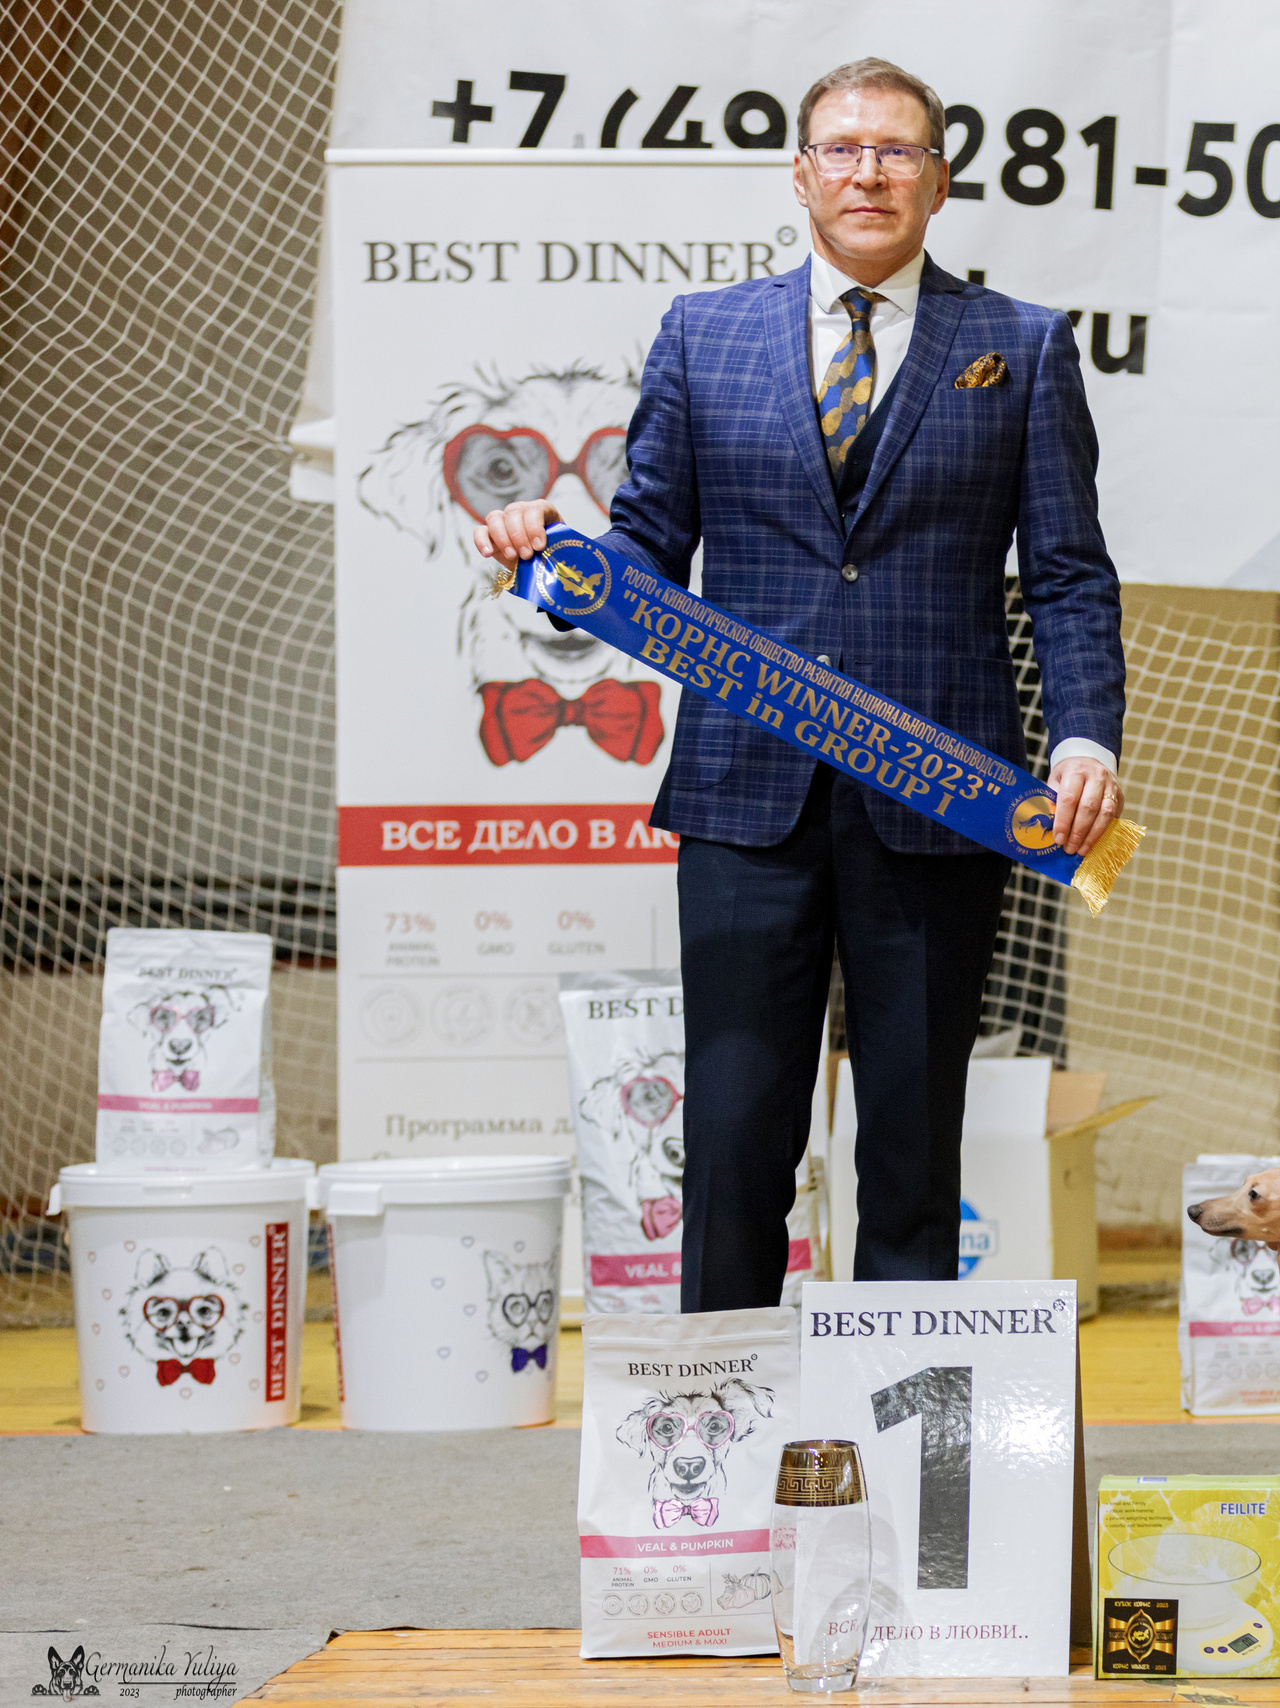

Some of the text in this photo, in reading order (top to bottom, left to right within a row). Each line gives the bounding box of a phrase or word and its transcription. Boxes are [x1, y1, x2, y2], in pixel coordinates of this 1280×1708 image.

[431, 70, 567, 149] +7
[363, 241, 777, 284] BEST DINNER
[621, 564, 658, 595] РООТО
[660, 586, 753, 646] КИНОЛОГИЧЕСКОЕ
[749, 633, 804, 674] ОБЩЕСТВО
[801, 661, 855, 701] РАЗВИТИЯ
[850, 686, 937, 744] НАЦИОНАЛЬНОГО
[933, 732, 1017, 787] СОБАКОВОДСТВА»
[623, 589, 1001, 800] "КОРНС WINNER-2023"
[639, 634, 743, 702] BEST
[744, 692, 785, 730] in
[794, 719, 931, 800] GROUP
[381, 820, 461, 852] ВСЕ
[467, 819, 579, 854] ДЕЛО
[588, 820, 616, 850] В
[384, 911, 596, 934] 73% 0% 0%
[588, 997, 661, 1021] BEST
[385, 1113, 544, 1142] Программа
[624, 1263, 669, 1279] VEAL
[270, 1231, 287, 1397] BEST DINNER
[810, 1308, 1057, 1337] BEST DINNER
[628, 1357, 754, 1378] BEST DINNER
[870, 1365, 973, 1590] 1
[1220, 1503, 1266, 1515] FEILITE
[637, 1538, 735, 1553] VEAL & PUMPKIN
[613, 1564, 687, 1576] 71% 0% 0%
[647, 1628, 732, 1639] SENSIBLE ADULT
[652, 1640, 693, 1648] MEDIUM
[705, 1638, 728, 1646] MAXI
[870, 1624, 923, 1643] ДЕЛО
[929, 1625, 941, 1640] В
[945, 1624, 1030, 1640] ЛЮБВИ..
